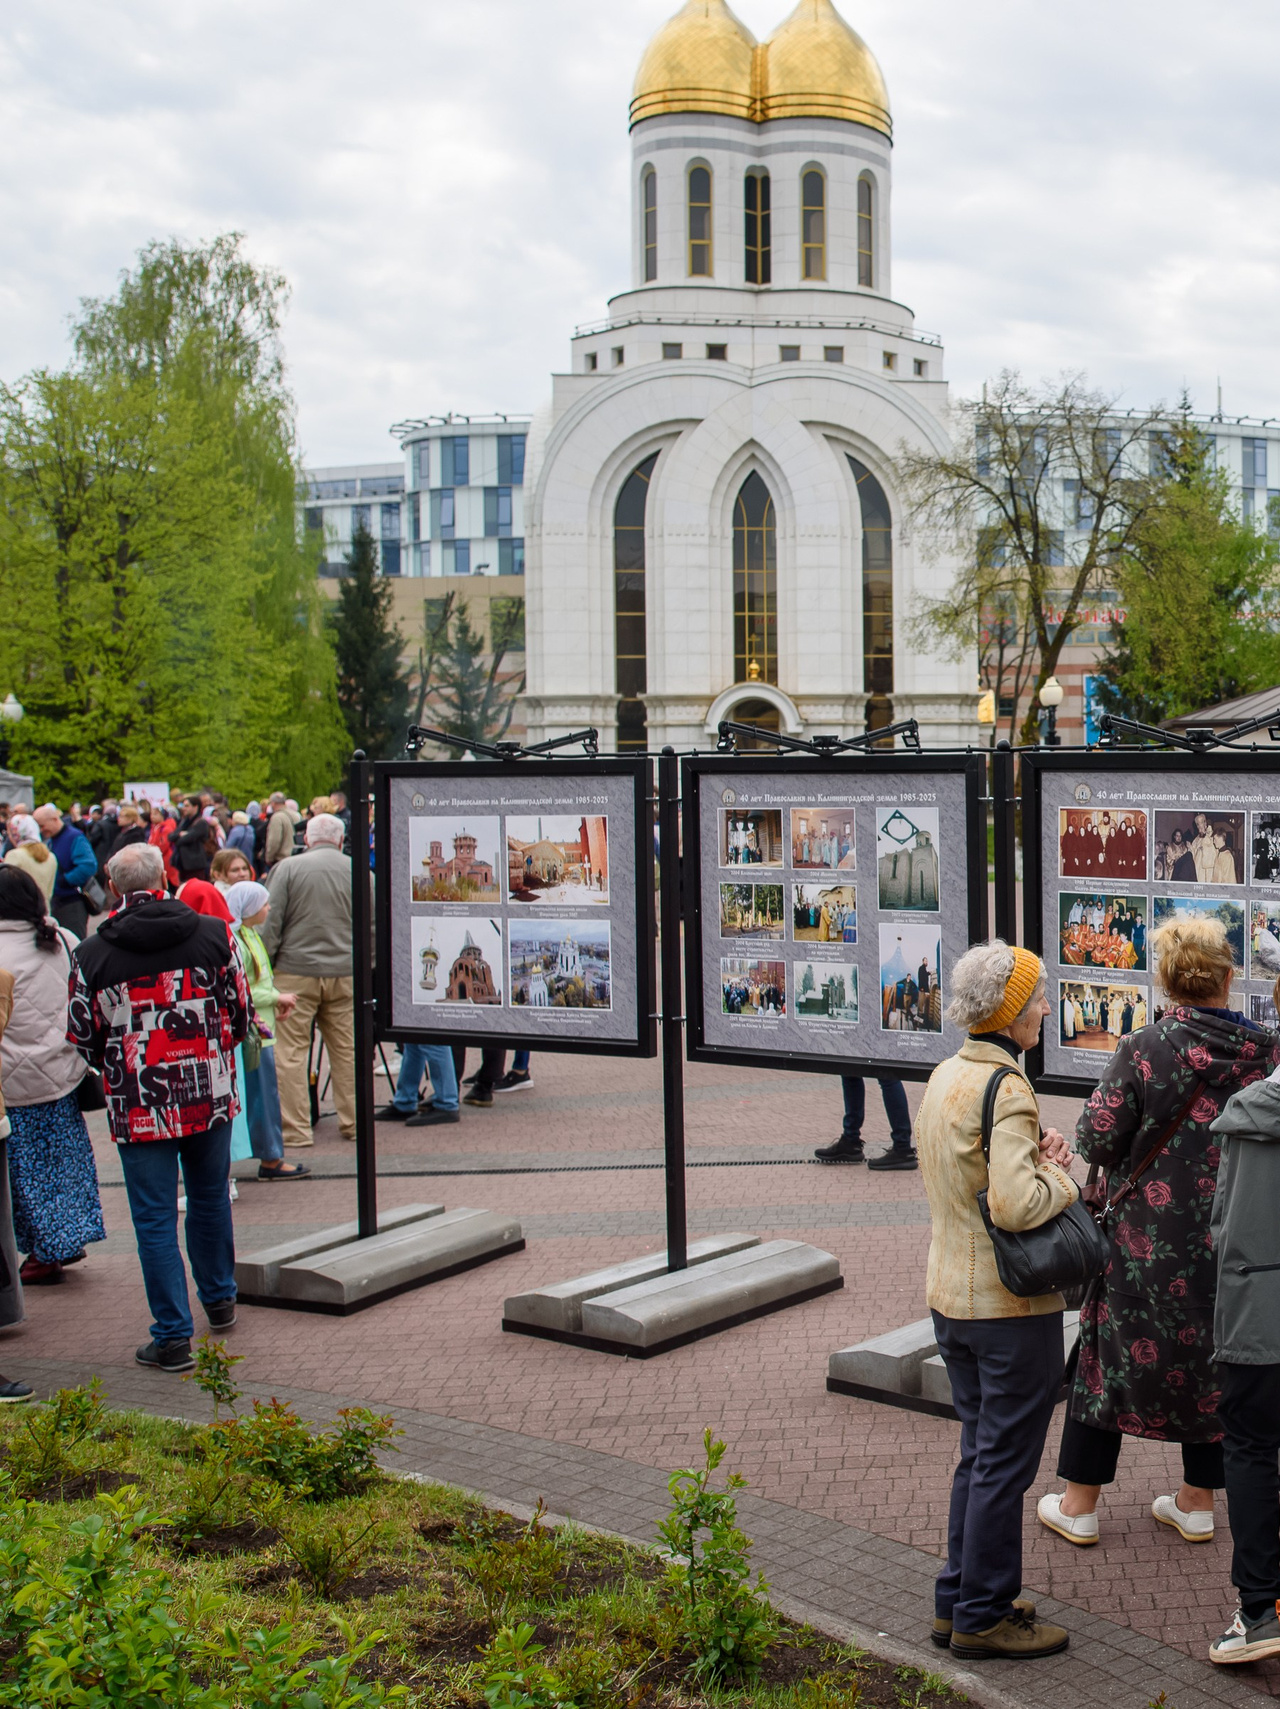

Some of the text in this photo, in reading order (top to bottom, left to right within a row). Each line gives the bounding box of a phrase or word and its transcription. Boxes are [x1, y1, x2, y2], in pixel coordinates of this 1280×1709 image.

[899, 793, 937, 802] 1985-2025
[1096, 791, 1107, 800] 40
[1109, 792, 1124, 800] лет
[1126, 791, 1177, 803] Православия
[1179, 792, 1189, 801] на
[1192, 791, 1263, 805] Калининградской
